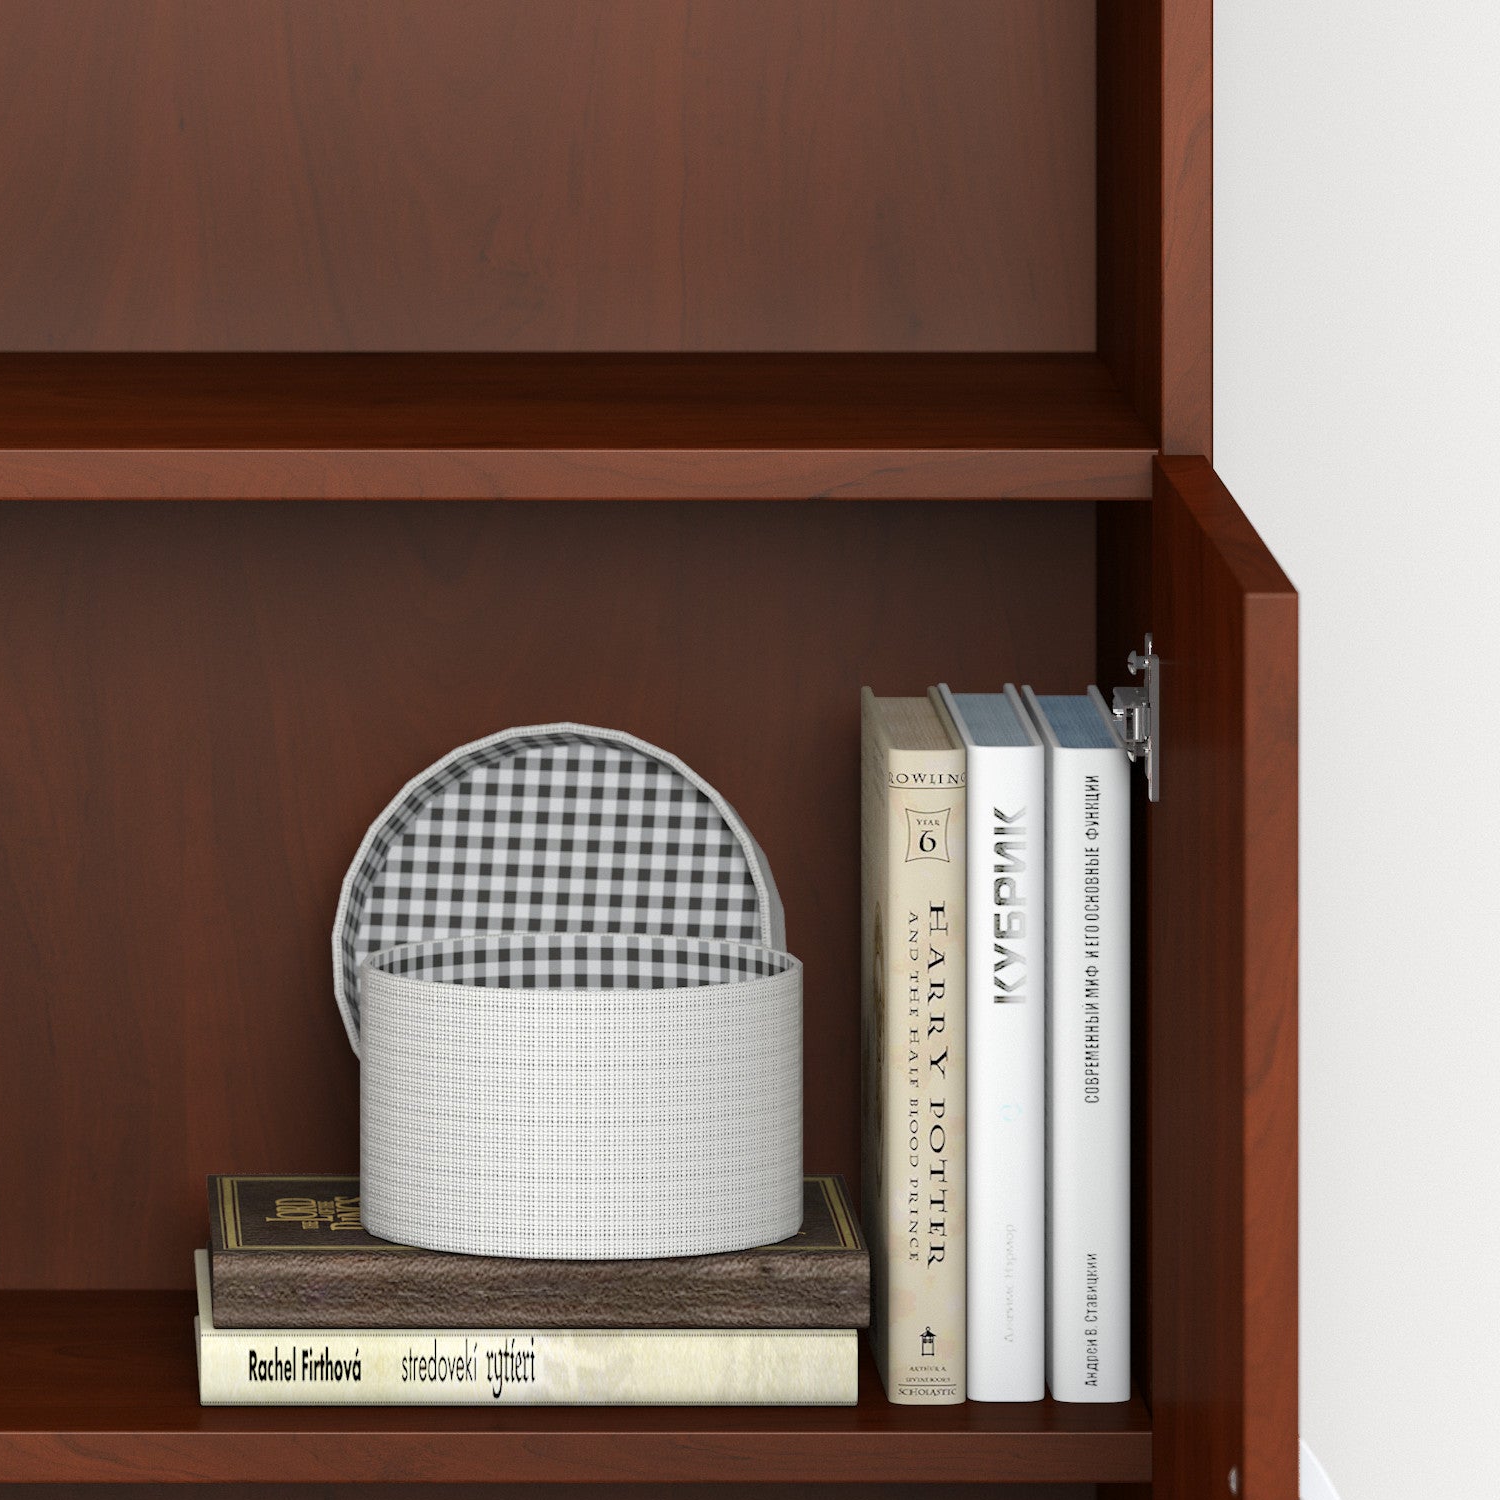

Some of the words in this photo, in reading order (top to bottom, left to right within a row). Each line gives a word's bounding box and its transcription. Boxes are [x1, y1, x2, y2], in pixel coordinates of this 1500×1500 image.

[916, 818, 940, 826] YEAR
[1084, 775, 1102, 840] ФУНКЦИИ
[919, 829, 937, 852] 6
[993, 806, 1027, 1004] КУБРИК
[1084, 847, 1100, 921] ОСНОВНЫЕ
[908, 911, 919, 962] AND
[1084, 926, 1100, 947] ЕГО
[1084, 950, 1100, 959] И
[908, 971, 920, 1017] THE
[927, 901, 949, 1079] HARRY
[1084, 966, 1100, 998] МИФ
[908, 1029, 920, 1088] HALF
[908, 1099, 920, 1168] BLOOD
[927, 1099, 949, 1269] POTTER
[908, 1179, 920, 1261] PRINCE
[248, 1346, 296, 1382] Rachel
[301, 1346, 362, 1382] Firthová
[401, 1338, 478, 1382] stredovekí
[898, 1388, 957, 1397] SCHOLASTIC
